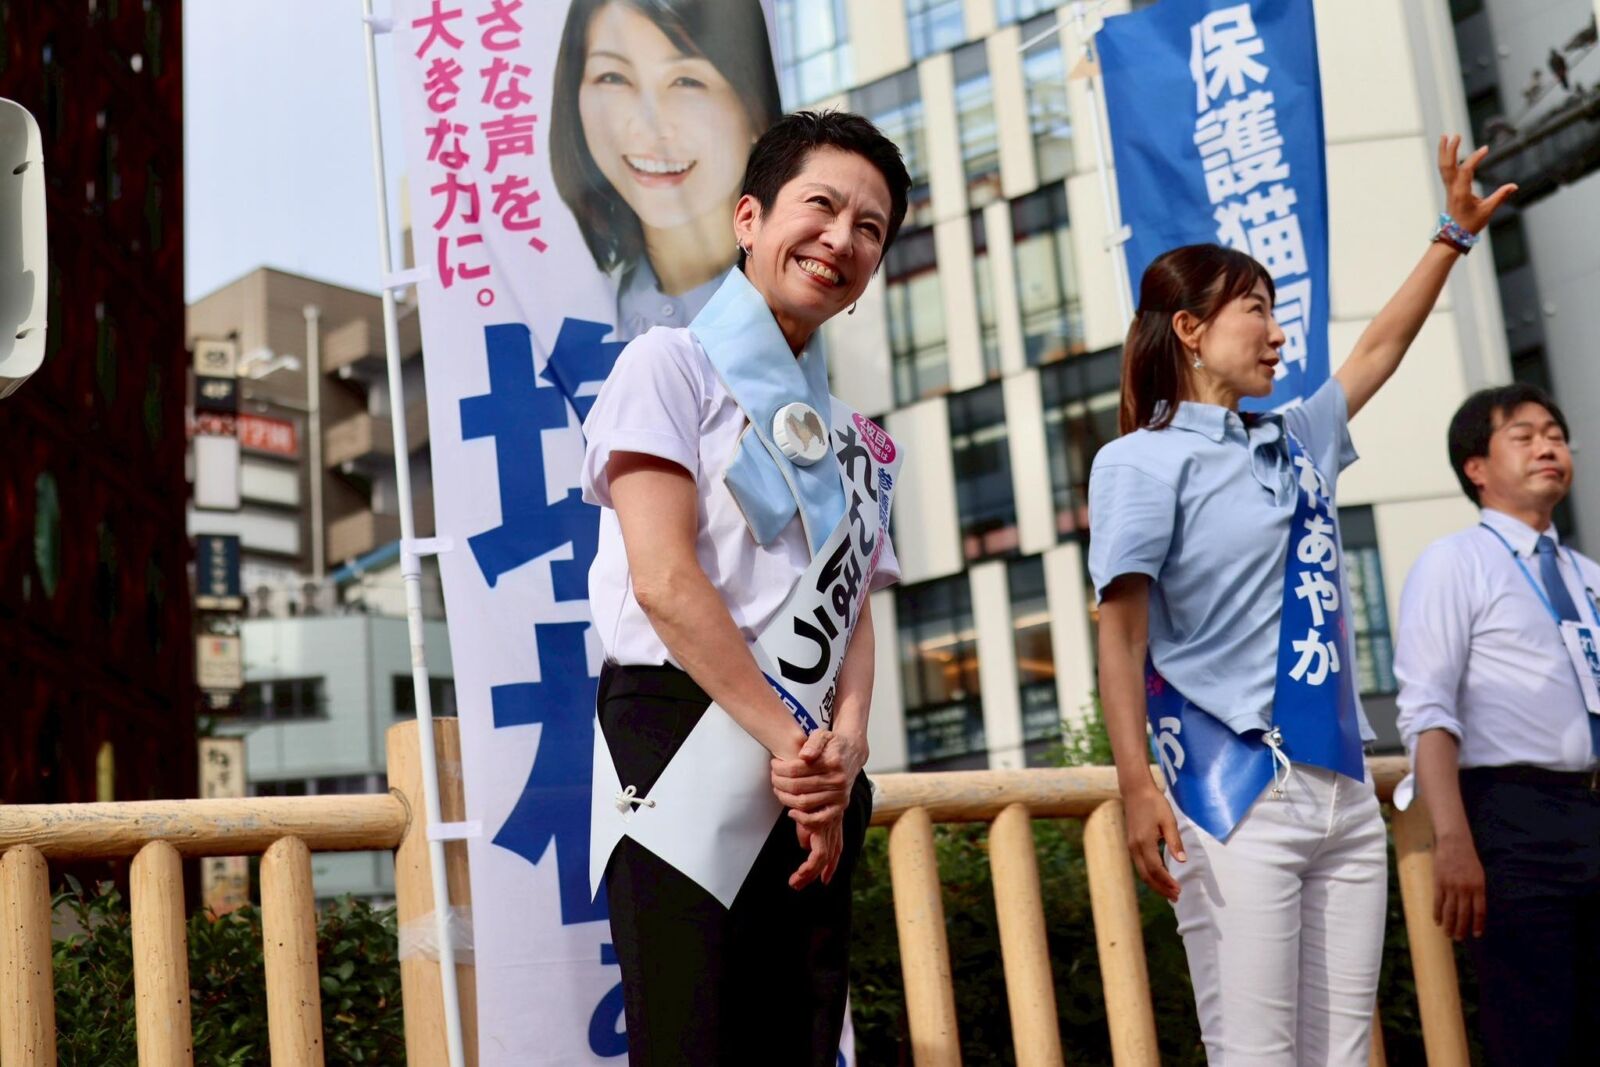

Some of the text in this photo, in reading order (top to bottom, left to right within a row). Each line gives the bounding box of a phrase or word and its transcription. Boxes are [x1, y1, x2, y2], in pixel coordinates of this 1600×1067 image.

[412, 0, 495, 307] 大きな力に。
[777, 424, 878, 685] れんほう
